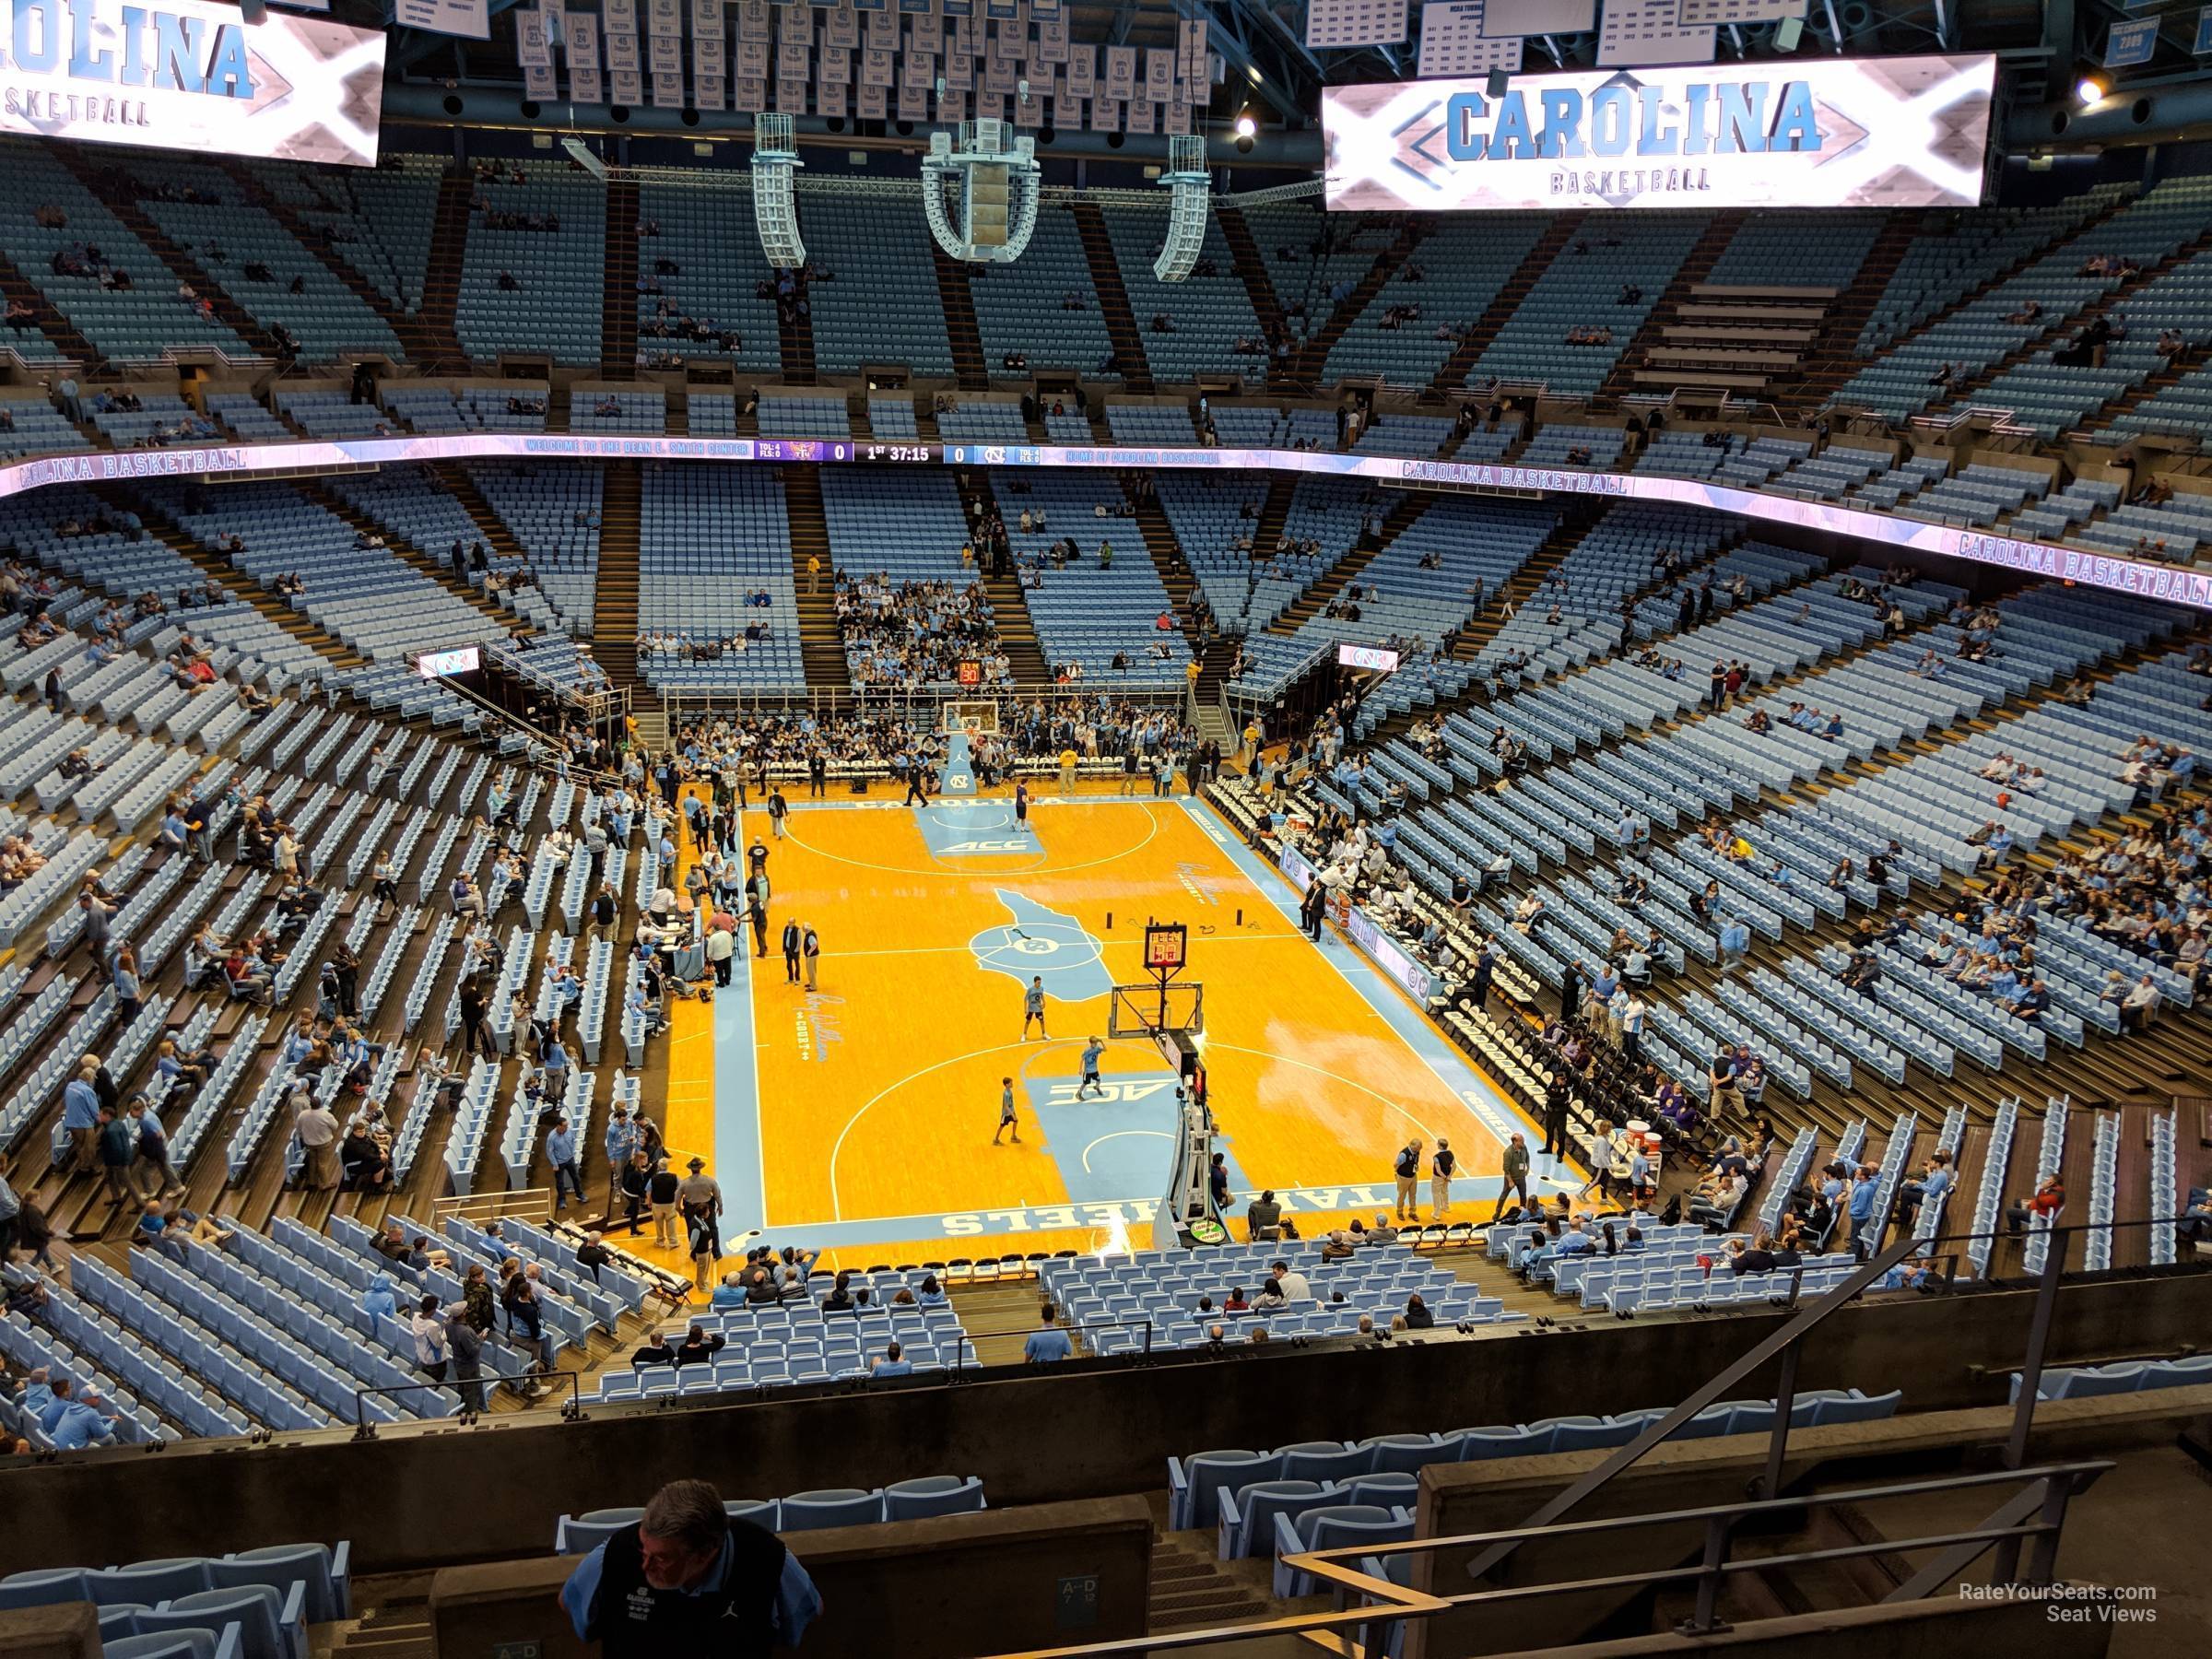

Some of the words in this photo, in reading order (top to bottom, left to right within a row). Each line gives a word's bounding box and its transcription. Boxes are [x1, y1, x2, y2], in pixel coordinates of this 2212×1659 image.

[0, 0, 253, 100] OLINA
[1447, 81, 1822, 161] CAROLINA
[1550, 169, 1711, 194] BASKETBALL
[526, 440, 581, 452] WELCOME
[583, 441, 596, 452] TO
[600, 441, 621, 453] THE
[624, 441, 652, 453] DEAN
[669, 442, 703, 454] SMITH
[707, 442, 748, 455] CENTER
[833, 445, 845, 460] 0
[890, 447, 929, 461] 37:15
[954, 448, 964, 462] 0
[20, 457, 95, 488] CAROLINA
[102, 449, 247, 478] BASKETBALL
[1401, 461, 1492, 485] CAROLINA
[1500, 468, 1628, 494] BASKETBALL
[1959, 533, 2055, 571] CAROLINA
[855, 794, 1070, 809] CAOLIA
[935, 840, 1030, 853] ACC
[1045, 1077, 1180, 1106] ACC
